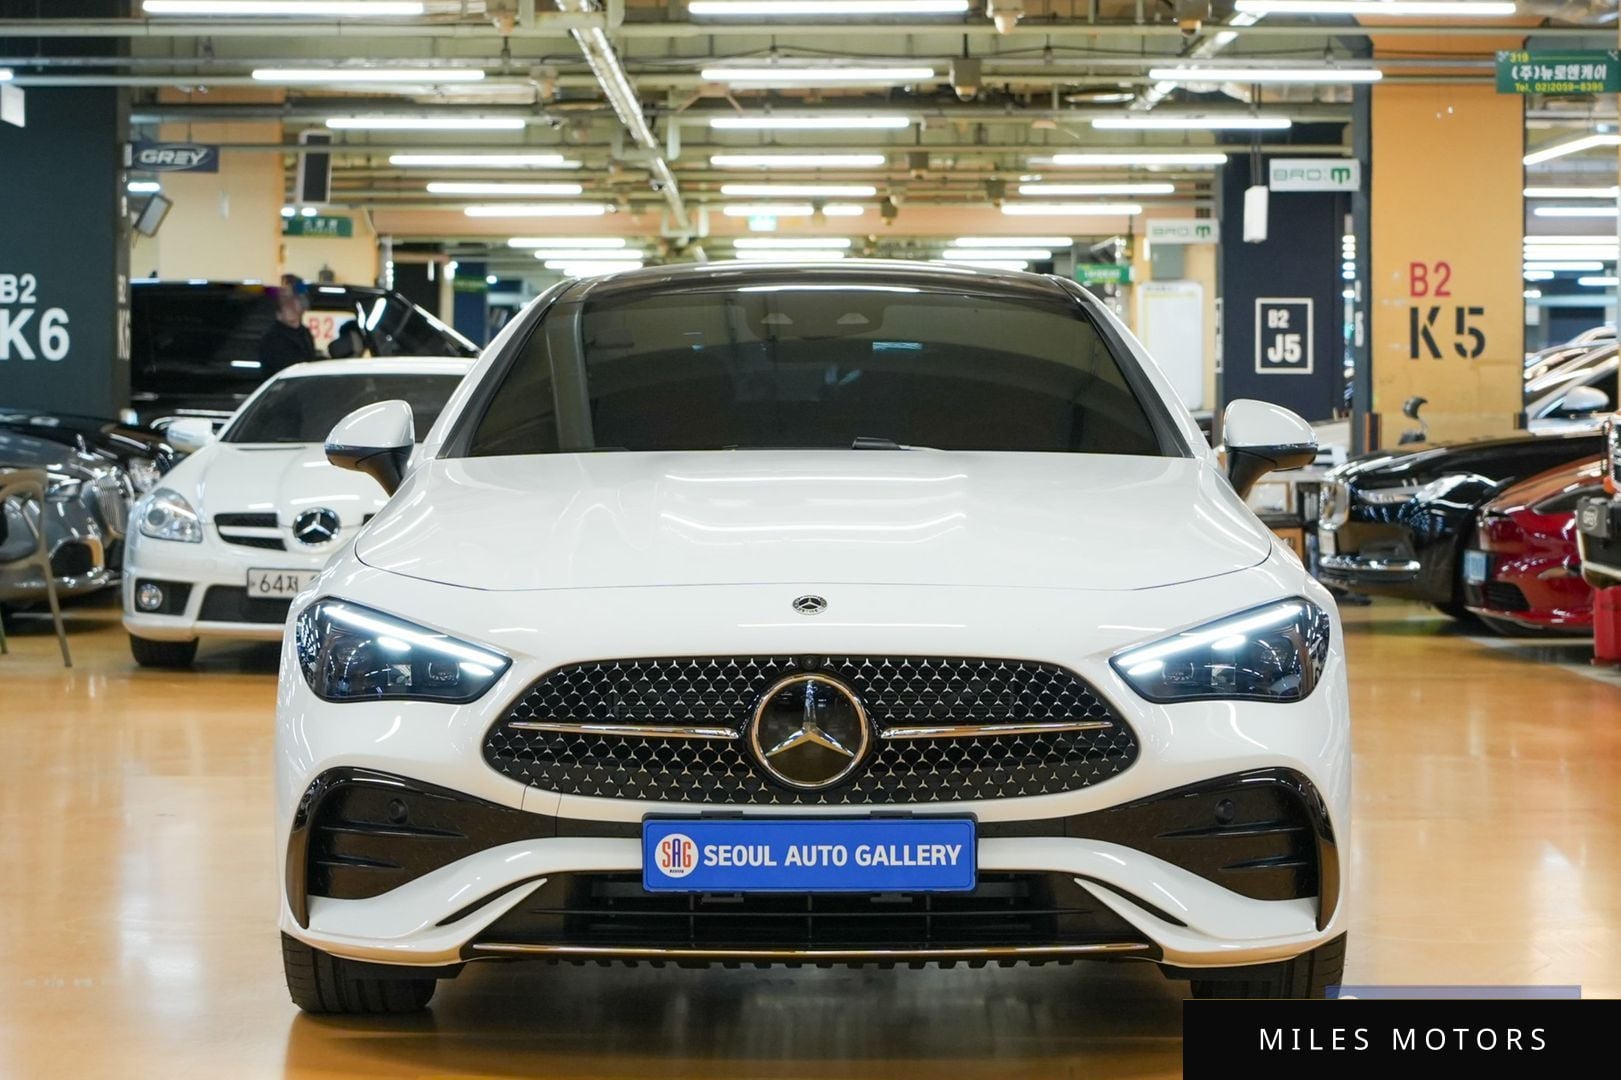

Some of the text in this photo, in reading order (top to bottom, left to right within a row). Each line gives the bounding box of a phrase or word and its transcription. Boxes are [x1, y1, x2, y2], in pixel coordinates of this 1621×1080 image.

[141, 147, 208, 165] GREY
[0, 273, 37, 304] B2
[1410, 261, 1452, 297] B2
[1268, 309, 1289, 328] B2
[1410, 306, 1485, 359] K5
[0, 307, 70, 361] K6
[1268, 334, 1301, 363] J5
[662, 838, 691, 867] SAG
[704, 845, 962, 866] SEOUL AUTO GALLERY
